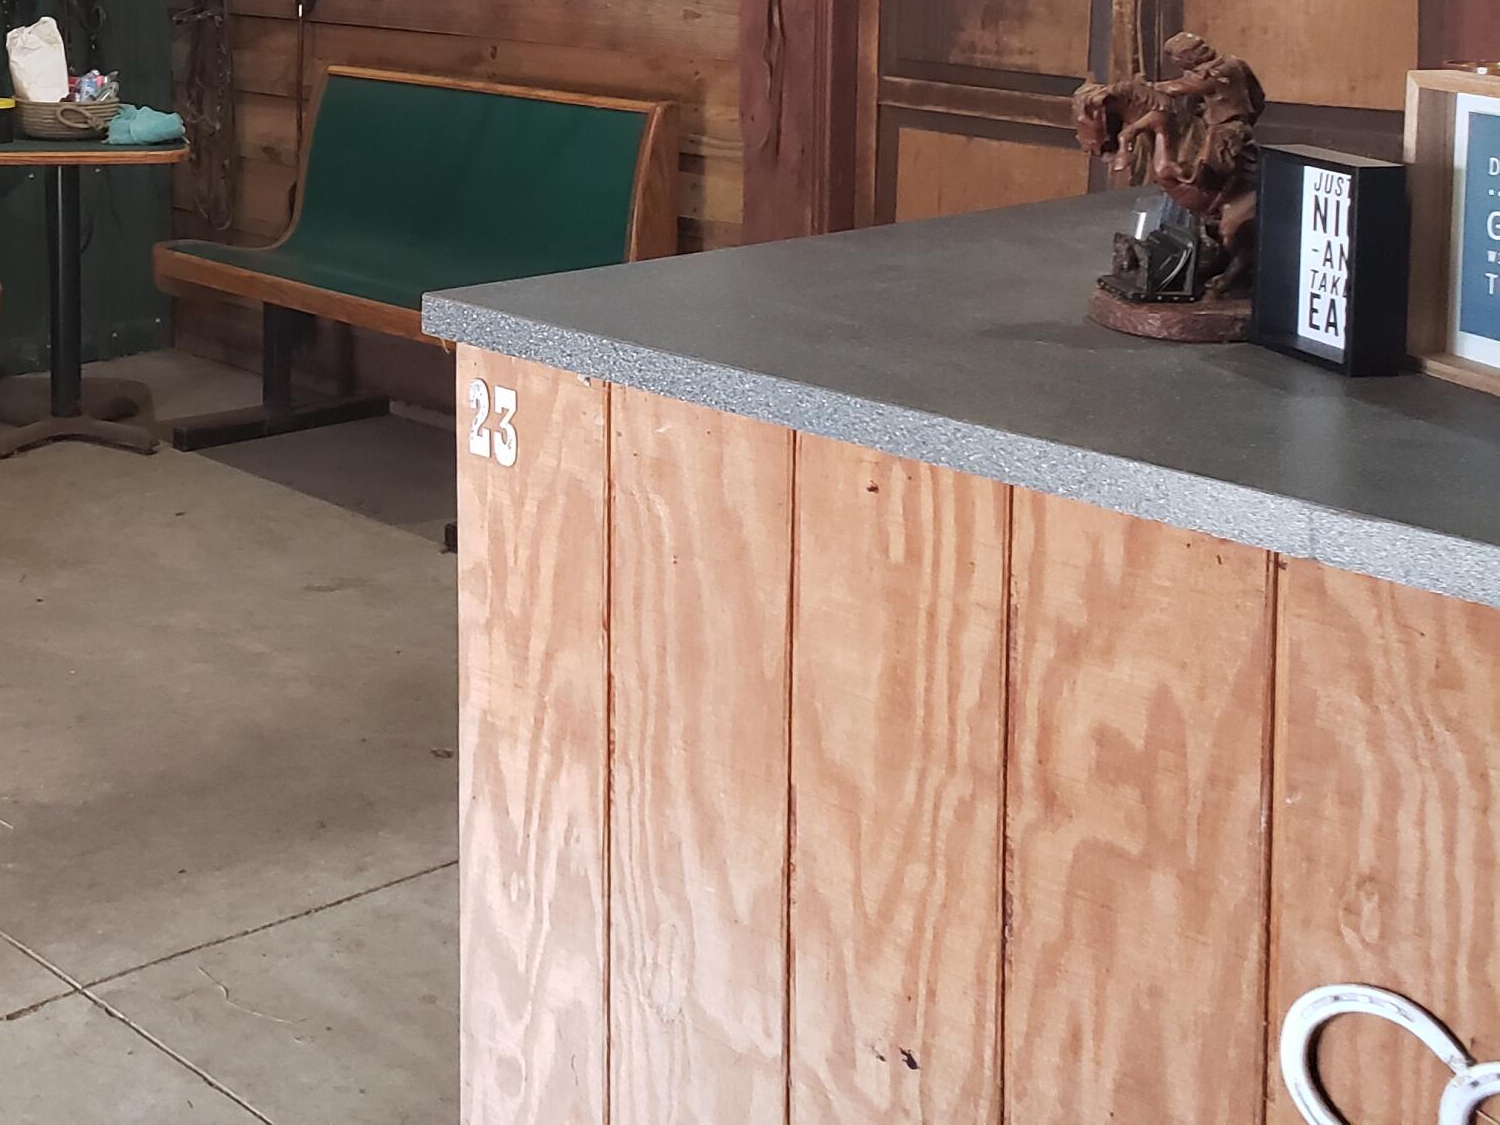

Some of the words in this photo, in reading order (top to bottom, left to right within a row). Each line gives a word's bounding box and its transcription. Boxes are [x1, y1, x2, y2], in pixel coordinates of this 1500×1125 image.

[1313, 194, 1349, 237] NI
[1308, 291, 1345, 338] EA
[467, 377, 518, 468] 23
